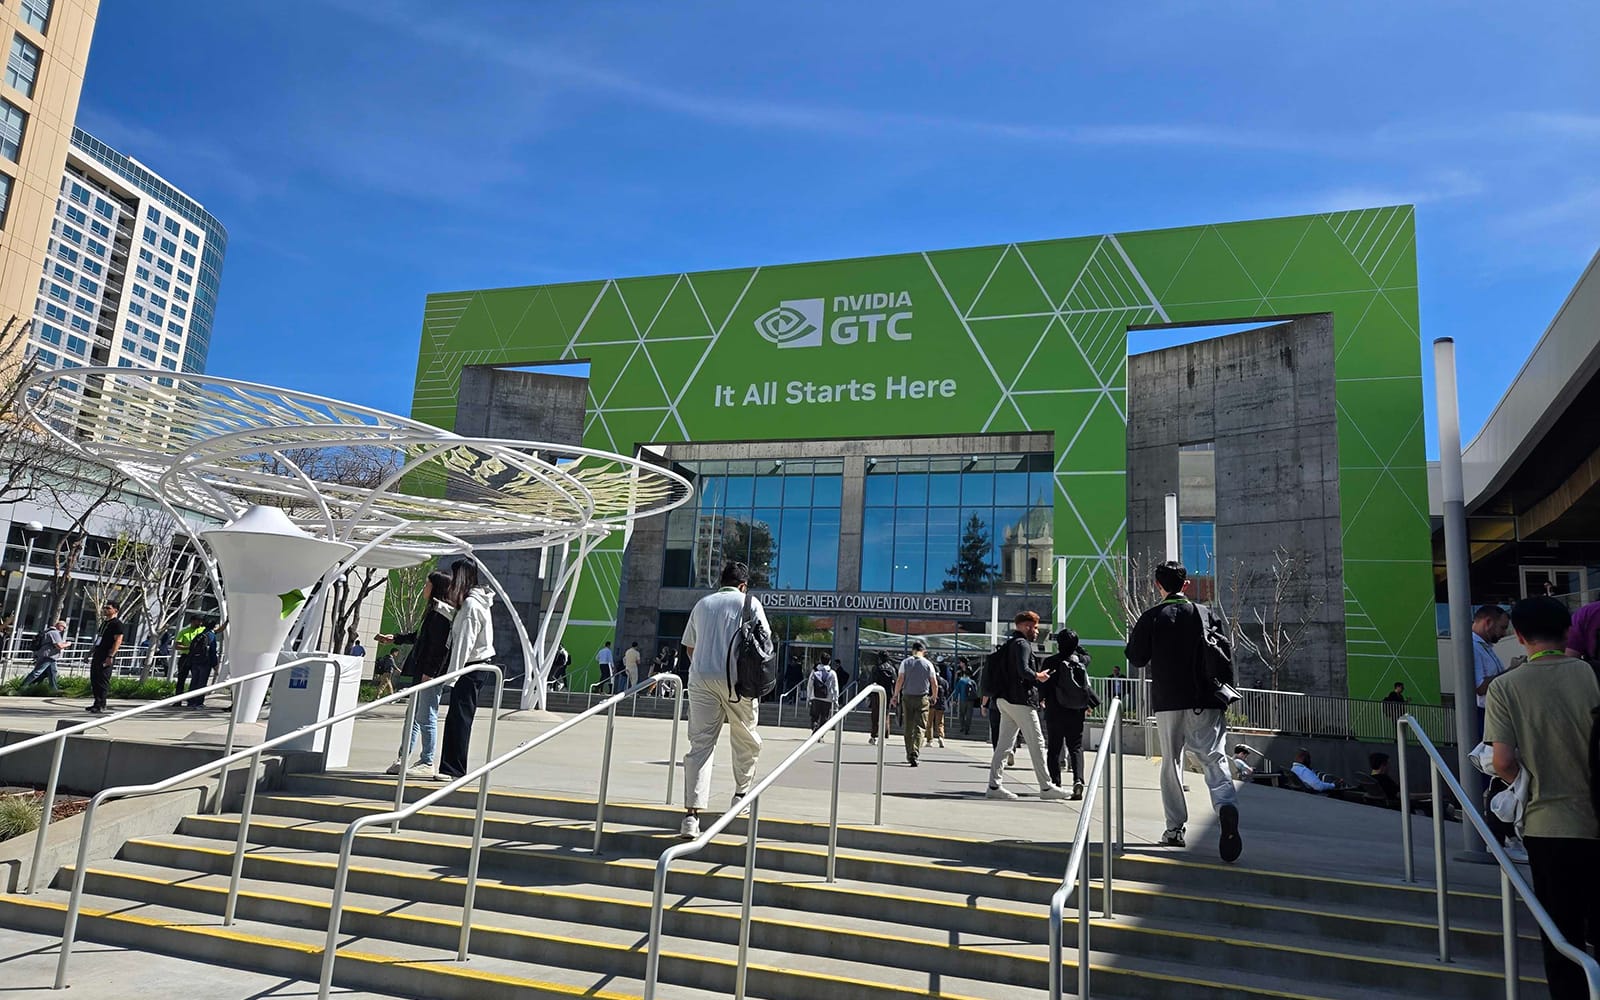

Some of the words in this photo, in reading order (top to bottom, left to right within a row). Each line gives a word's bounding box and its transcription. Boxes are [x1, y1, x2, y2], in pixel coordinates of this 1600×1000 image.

[830, 312, 913, 345] GTC
[714, 384, 735, 407] It
[742, 381, 778, 406] All
[785, 379, 876, 404] Starts
[886, 375, 957, 399] Here
[844, 595, 919, 610] CONVENTION
[925, 597, 971, 612] CENTER
